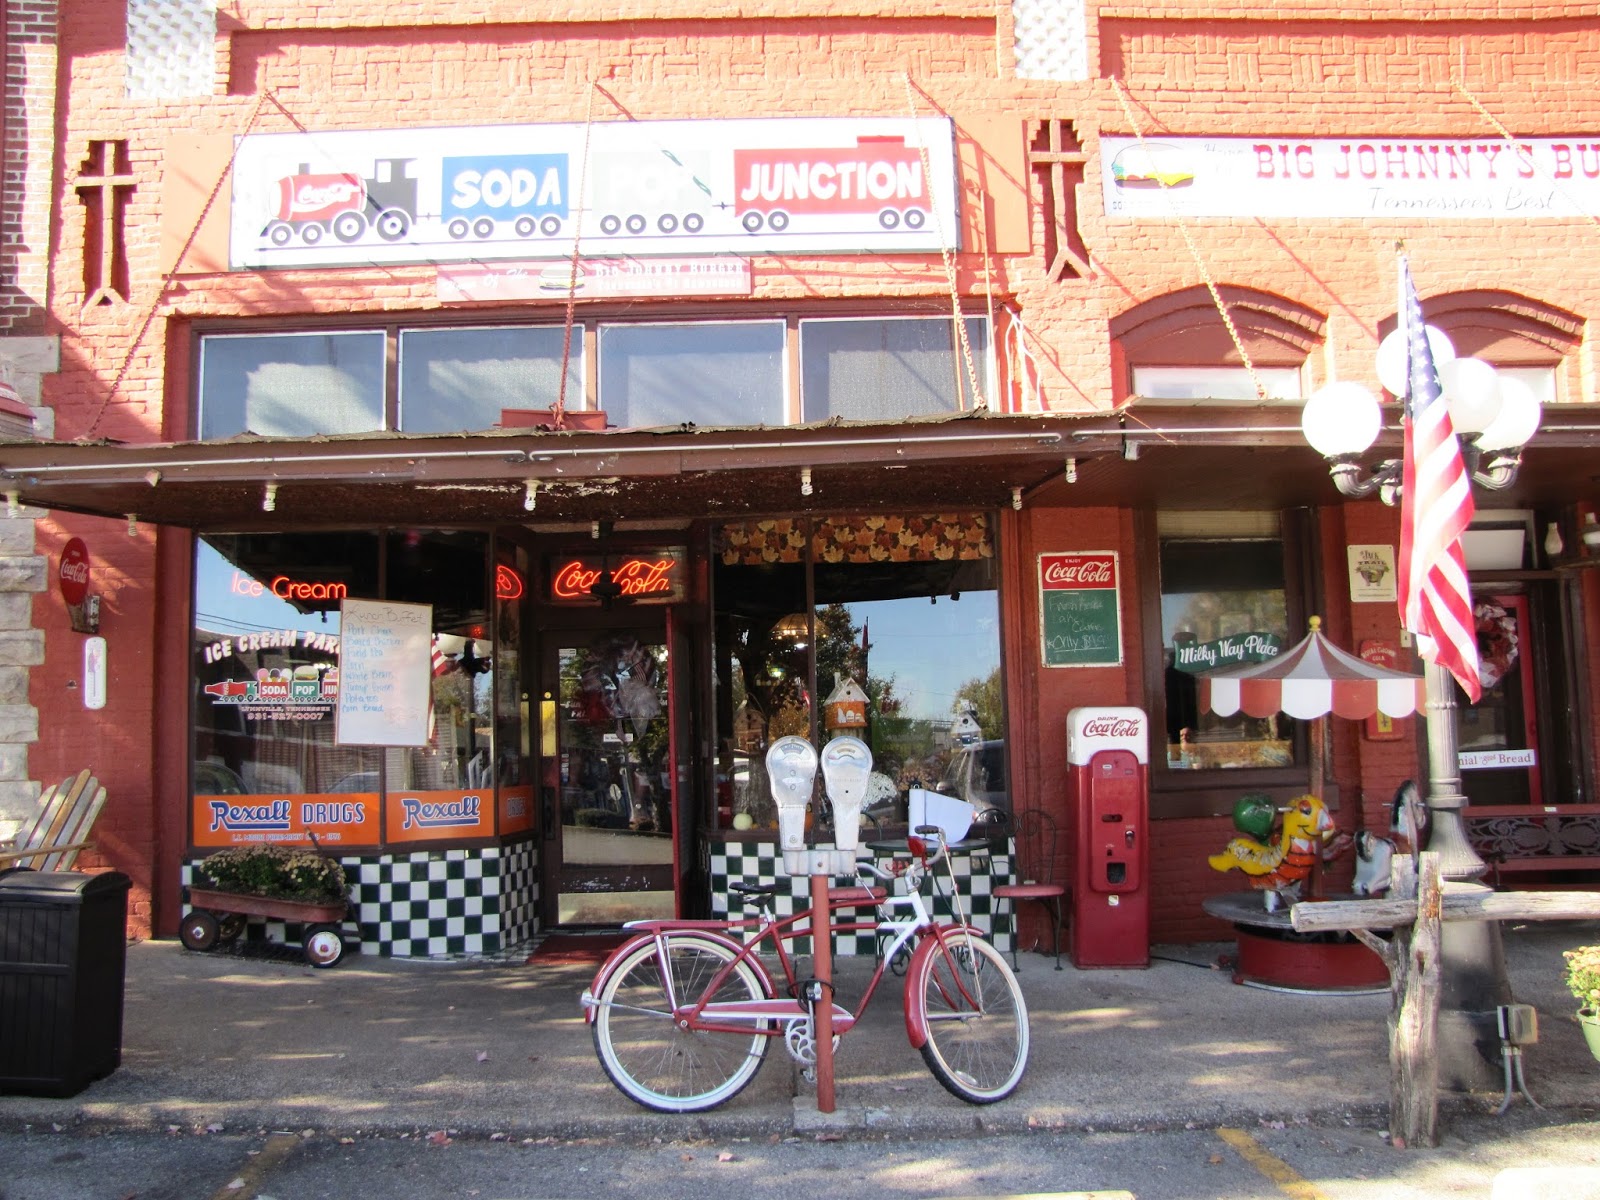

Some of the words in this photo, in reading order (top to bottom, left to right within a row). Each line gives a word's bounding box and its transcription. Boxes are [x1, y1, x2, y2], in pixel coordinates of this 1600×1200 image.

[1253, 144, 1315, 179] BIG
[1334, 144, 1534, 179] JOHNNY'S
[451, 167, 562, 208] SODA
[741, 161, 923, 201] JUNCTION
[1505, 187, 1555, 211] Best
[231, 572, 263, 597] Ice
[272, 575, 347, 600] Cream
[1045, 561, 1112, 583] Coca-Cola
[205, 639, 232, 664] ICE
[238, 630, 297, 652] CREAM
[303, 631, 340, 654] PAR
[1180, 640, 1217, 665] Milky
[1218, 638, 1245, 658] Way
[1245, 635, 1278, 657] Place
[261, 685, 287, 695] SODA
[295, 685, 316, 695] POP
[1082, 719, 1141, 737] Coca-Cola
[1458, 755, 1477, 765] nial
[1499, 753, 1531, 764] Bread
[210, 800, 292, 831] Rexall
[302, 803, 366, 825] DRUGS
[401, 796, 480, 830] Rexall
